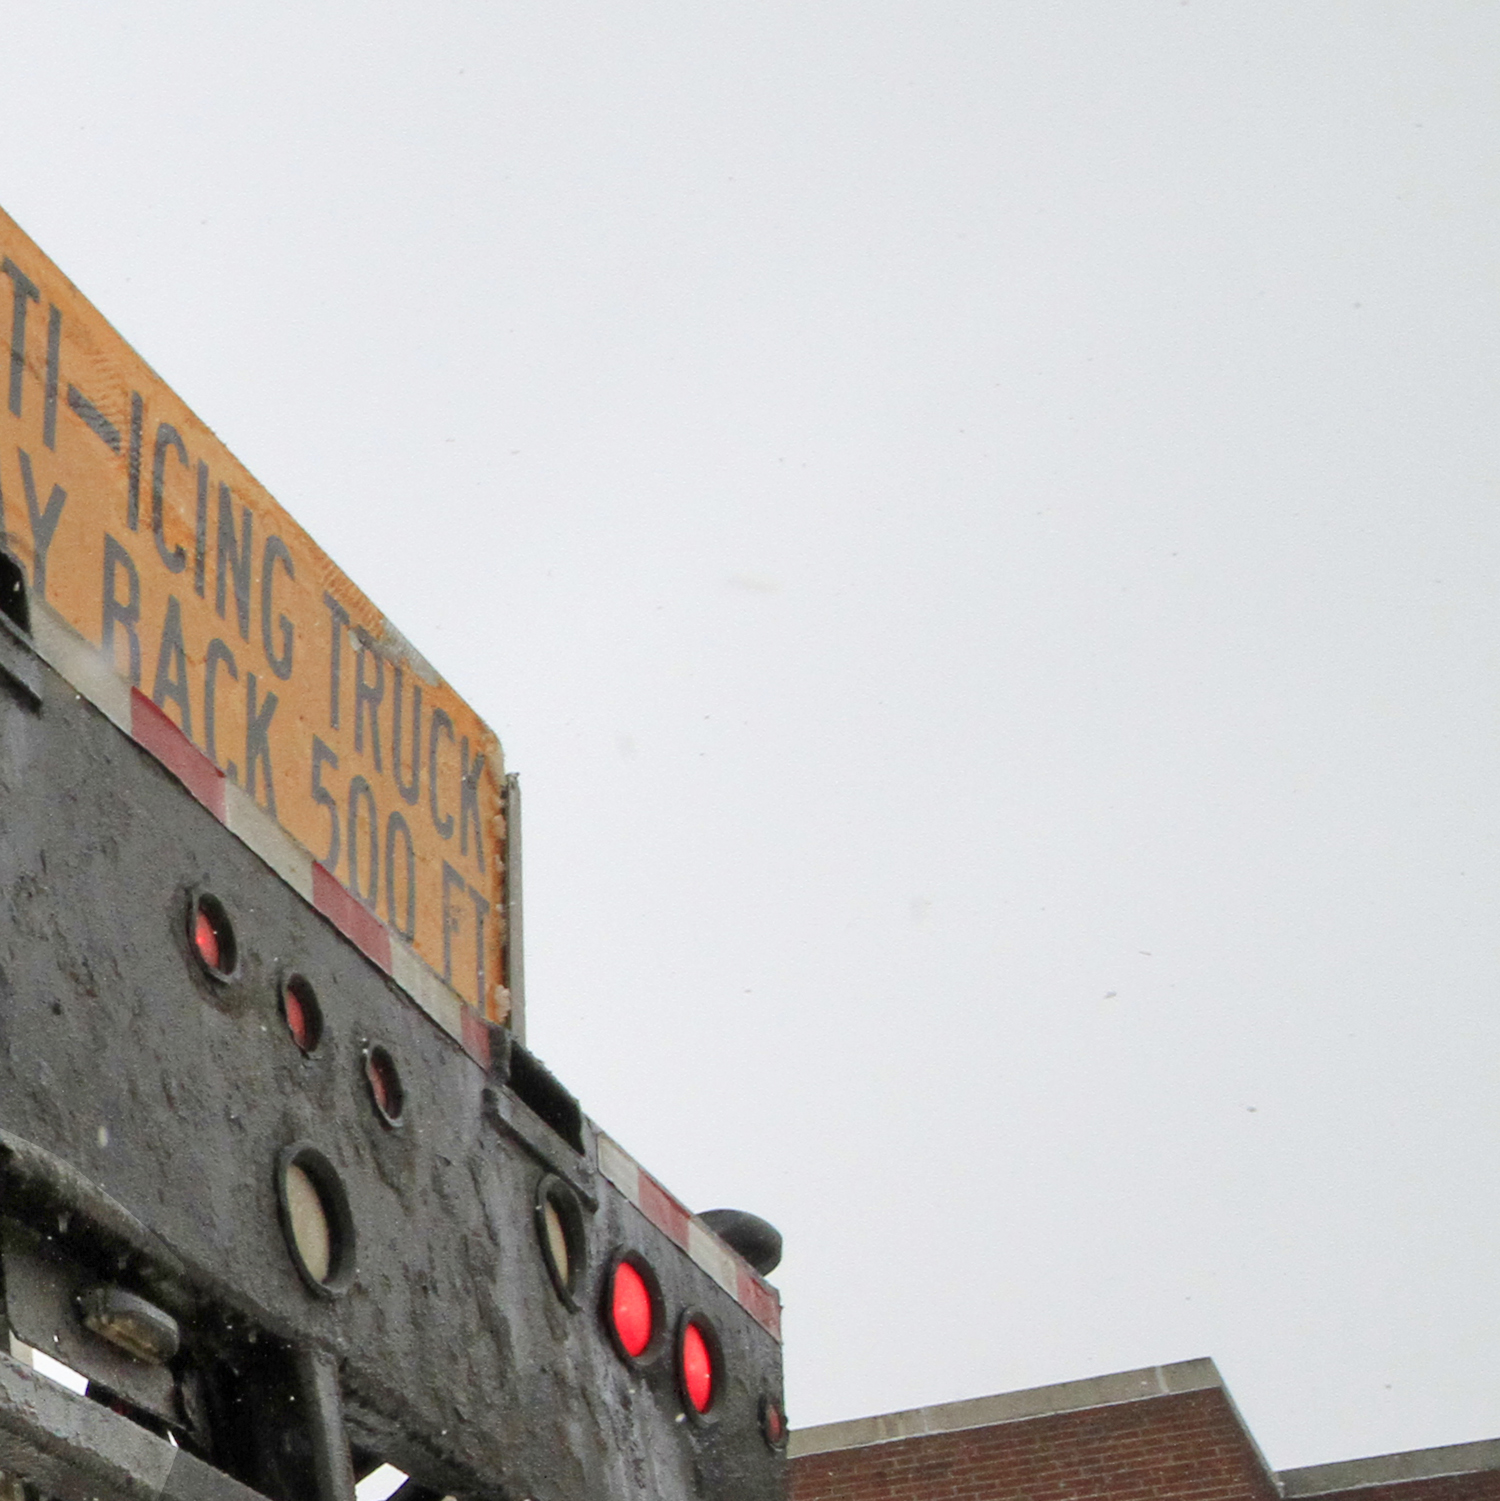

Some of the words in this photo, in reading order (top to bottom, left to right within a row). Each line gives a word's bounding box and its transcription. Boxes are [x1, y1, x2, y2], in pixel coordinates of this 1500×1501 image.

[99, 531, 279, 821] BACK
[311, 734, 416, 945] 500
[441, 859, 490, 1017] FT
[323, 590, 486, 874] TRUCK
